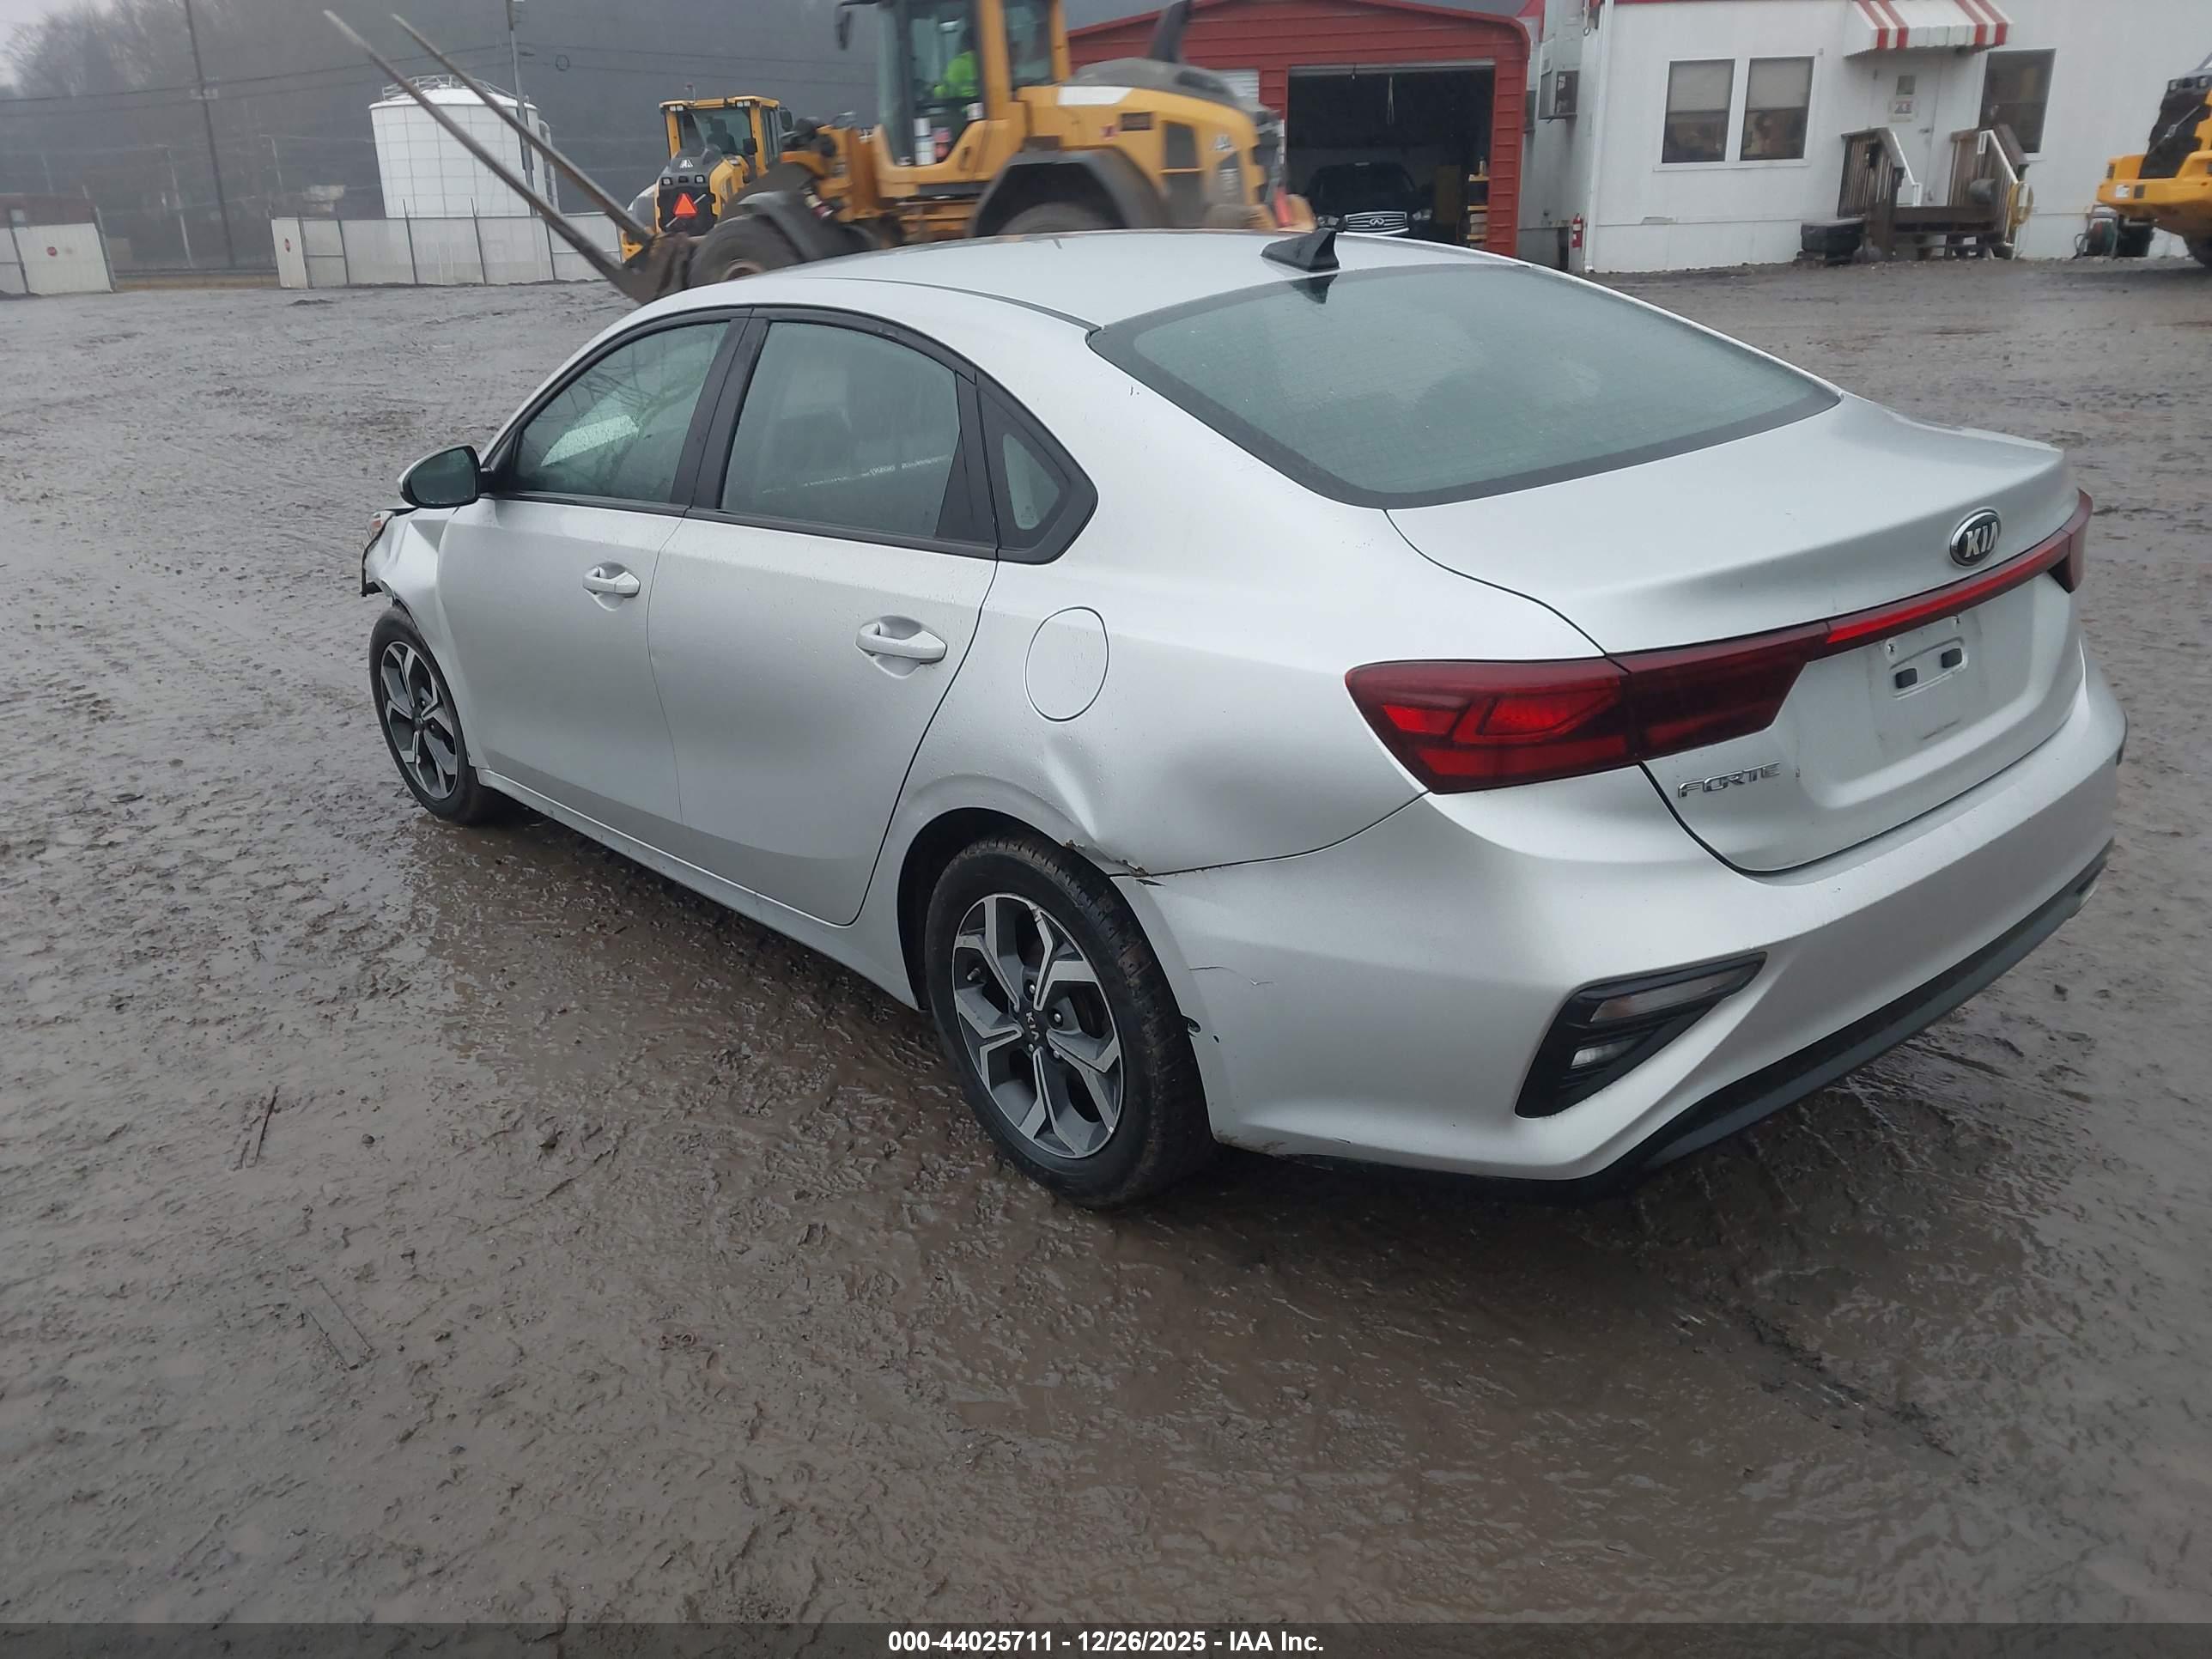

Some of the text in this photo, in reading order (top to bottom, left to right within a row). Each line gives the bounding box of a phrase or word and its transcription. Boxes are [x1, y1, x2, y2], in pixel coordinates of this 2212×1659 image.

[1964, 521, 1998, 558] KIA
[1678, 762, 1780, 798] FORTE
[1026, 1012, 1039, 1041] KIA
